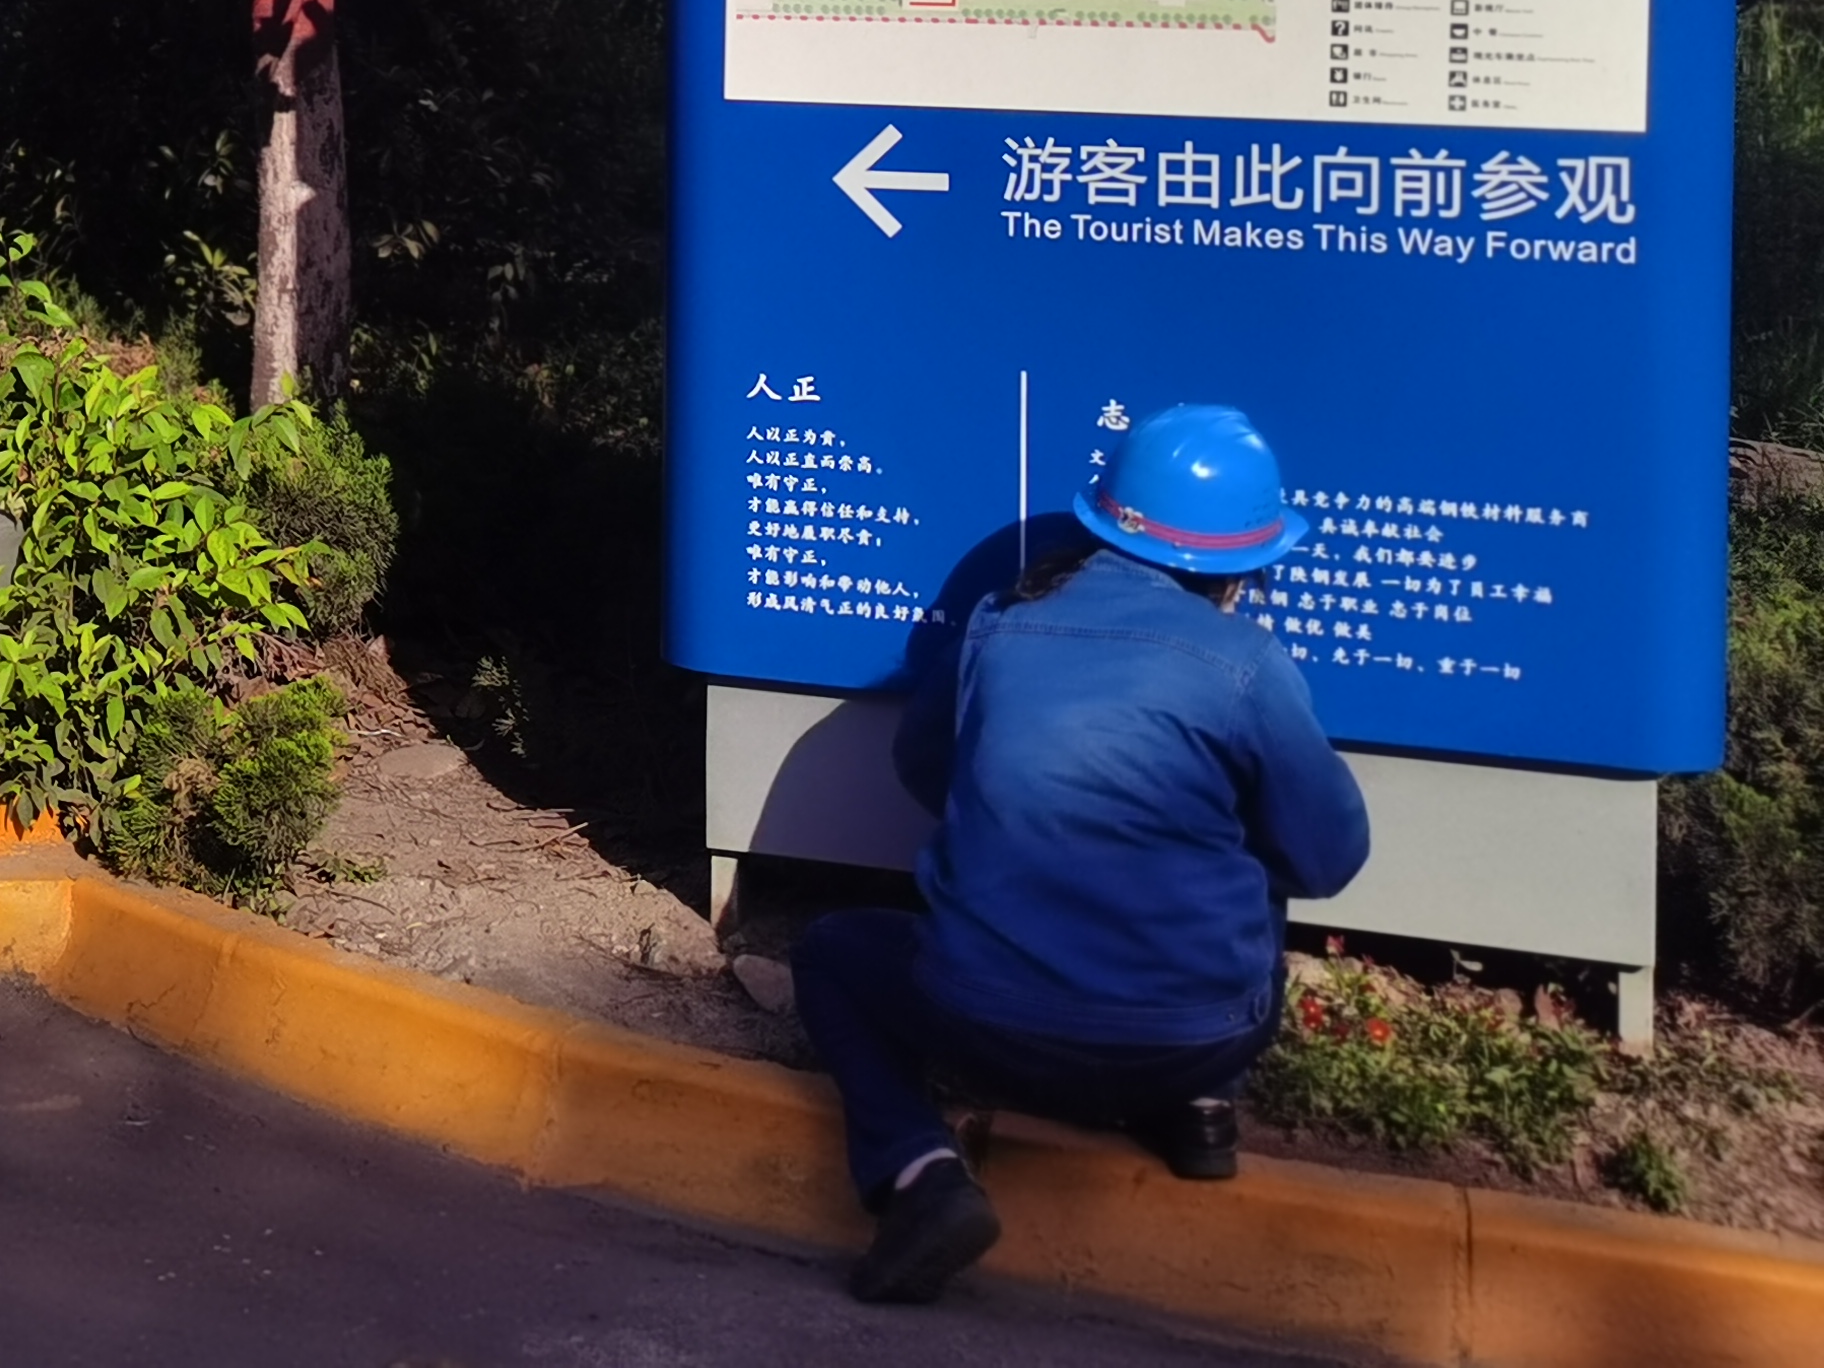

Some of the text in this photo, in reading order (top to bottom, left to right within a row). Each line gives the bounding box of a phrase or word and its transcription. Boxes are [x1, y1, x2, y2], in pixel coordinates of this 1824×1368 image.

[1001, 135, 1636, 225] 游客由此向前参观
[1001, 211, 1637, 265] The Tourist Makes This Way Forward
[746, 373, 821, 402] 人正
